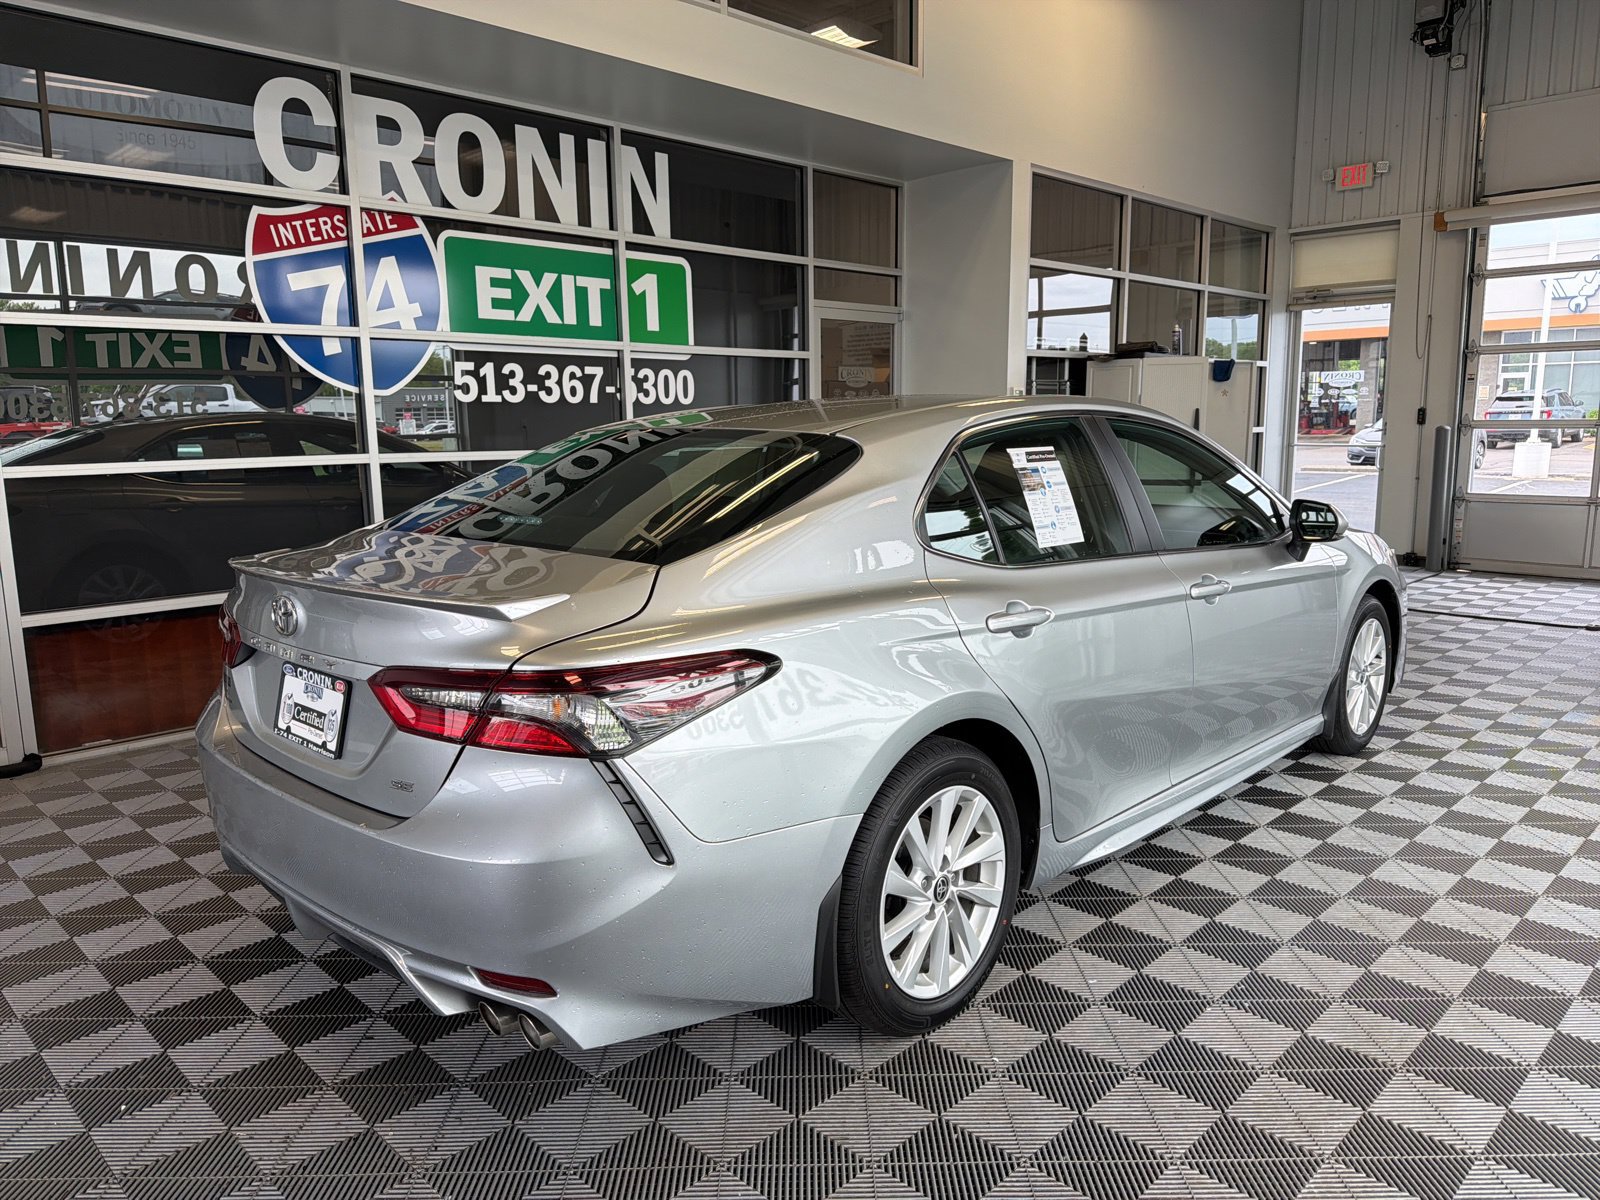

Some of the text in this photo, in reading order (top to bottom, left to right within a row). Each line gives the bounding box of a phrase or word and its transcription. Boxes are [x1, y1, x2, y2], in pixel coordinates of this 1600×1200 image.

[162, 133, 196, 150] 1945
[253, 76, 671, 239] CRONIN
[1342, 163, 1368, 187] EXIT
[269, 210, 398, 248] INTERSATE
[286, 255, 423, 356] 74
[474, 265, 660, 332] EXIT 1
[297, 667, 332, 689] CRONIN
[294, 706, 324, 729] Certified
[288, 734, 302, 744] EXIT
[308, 742, 335, 759] Harrison
